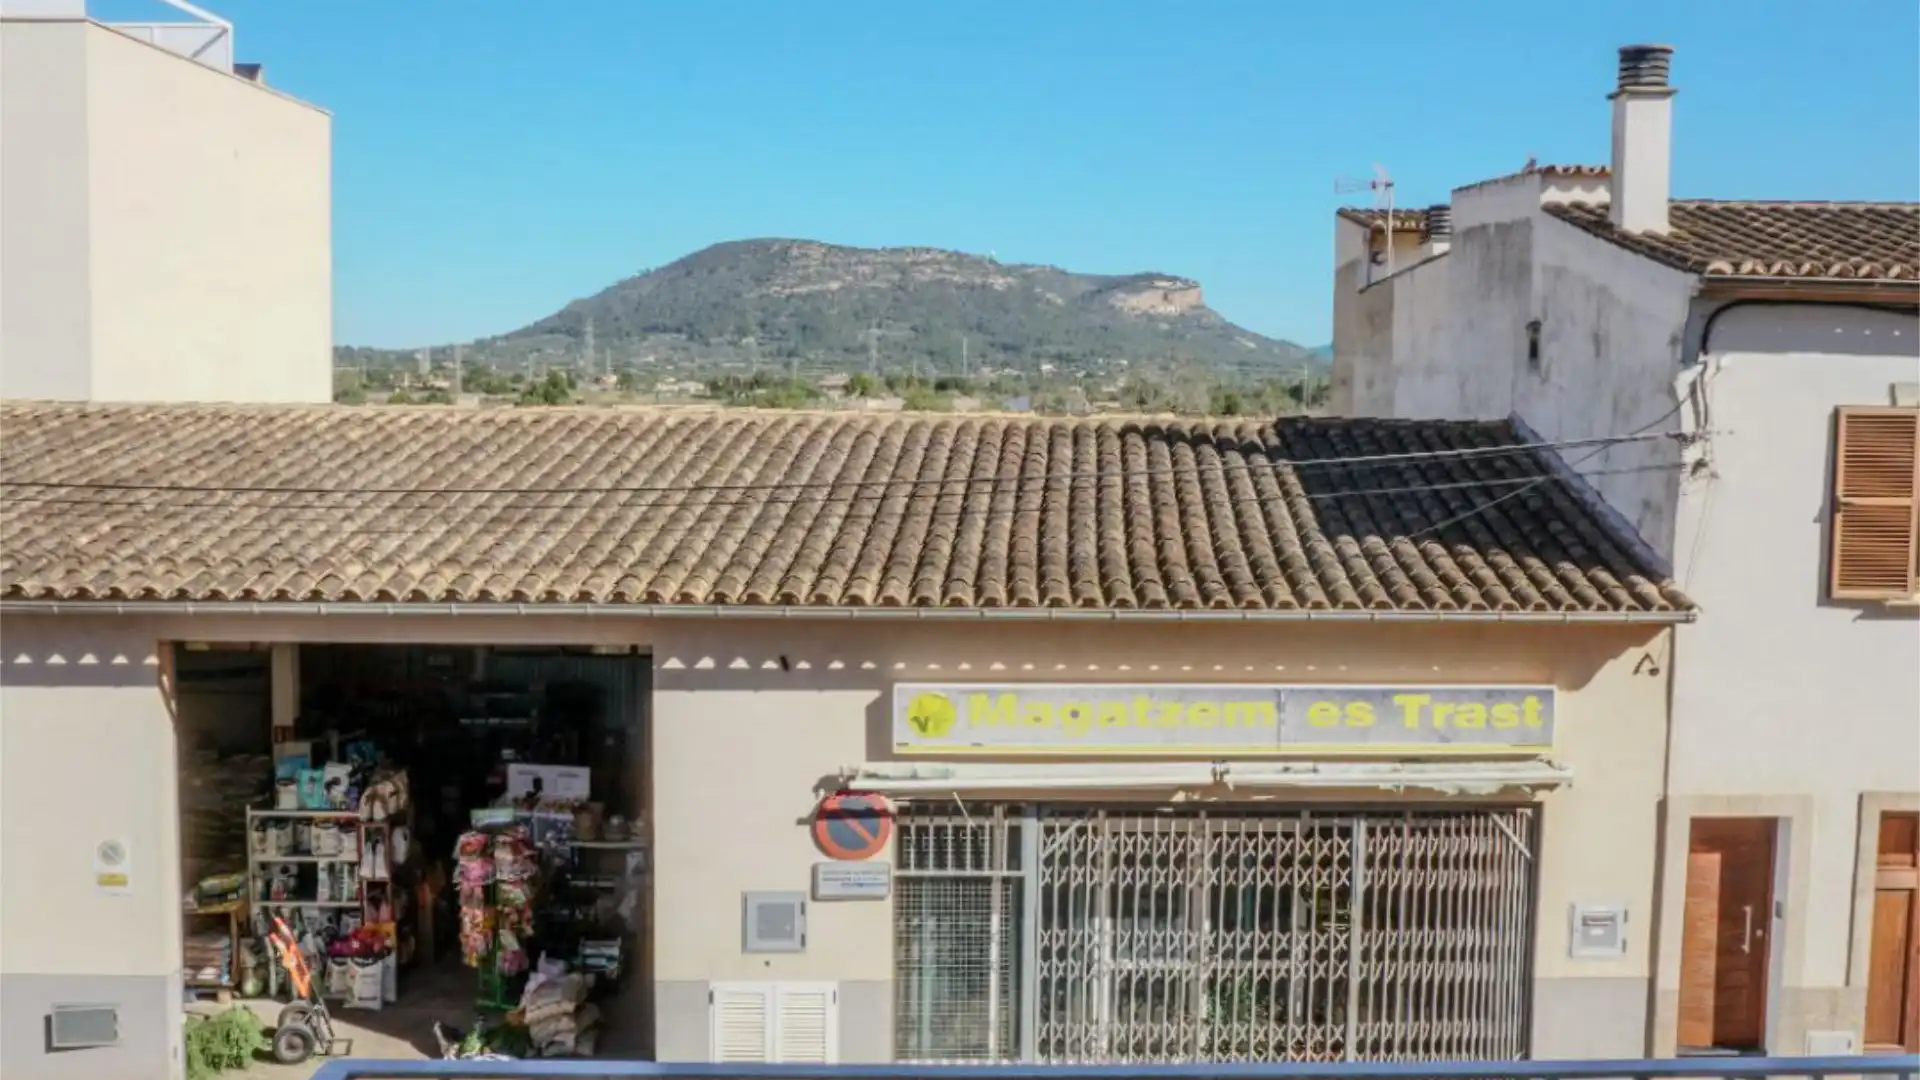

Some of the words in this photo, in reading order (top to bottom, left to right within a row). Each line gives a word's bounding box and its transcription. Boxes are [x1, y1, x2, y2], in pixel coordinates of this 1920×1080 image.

[967, 692, 1276, 736] Magatzem
[1307, 701, 1377, 728] es
[1393, 693, 1543, 730] Trast
